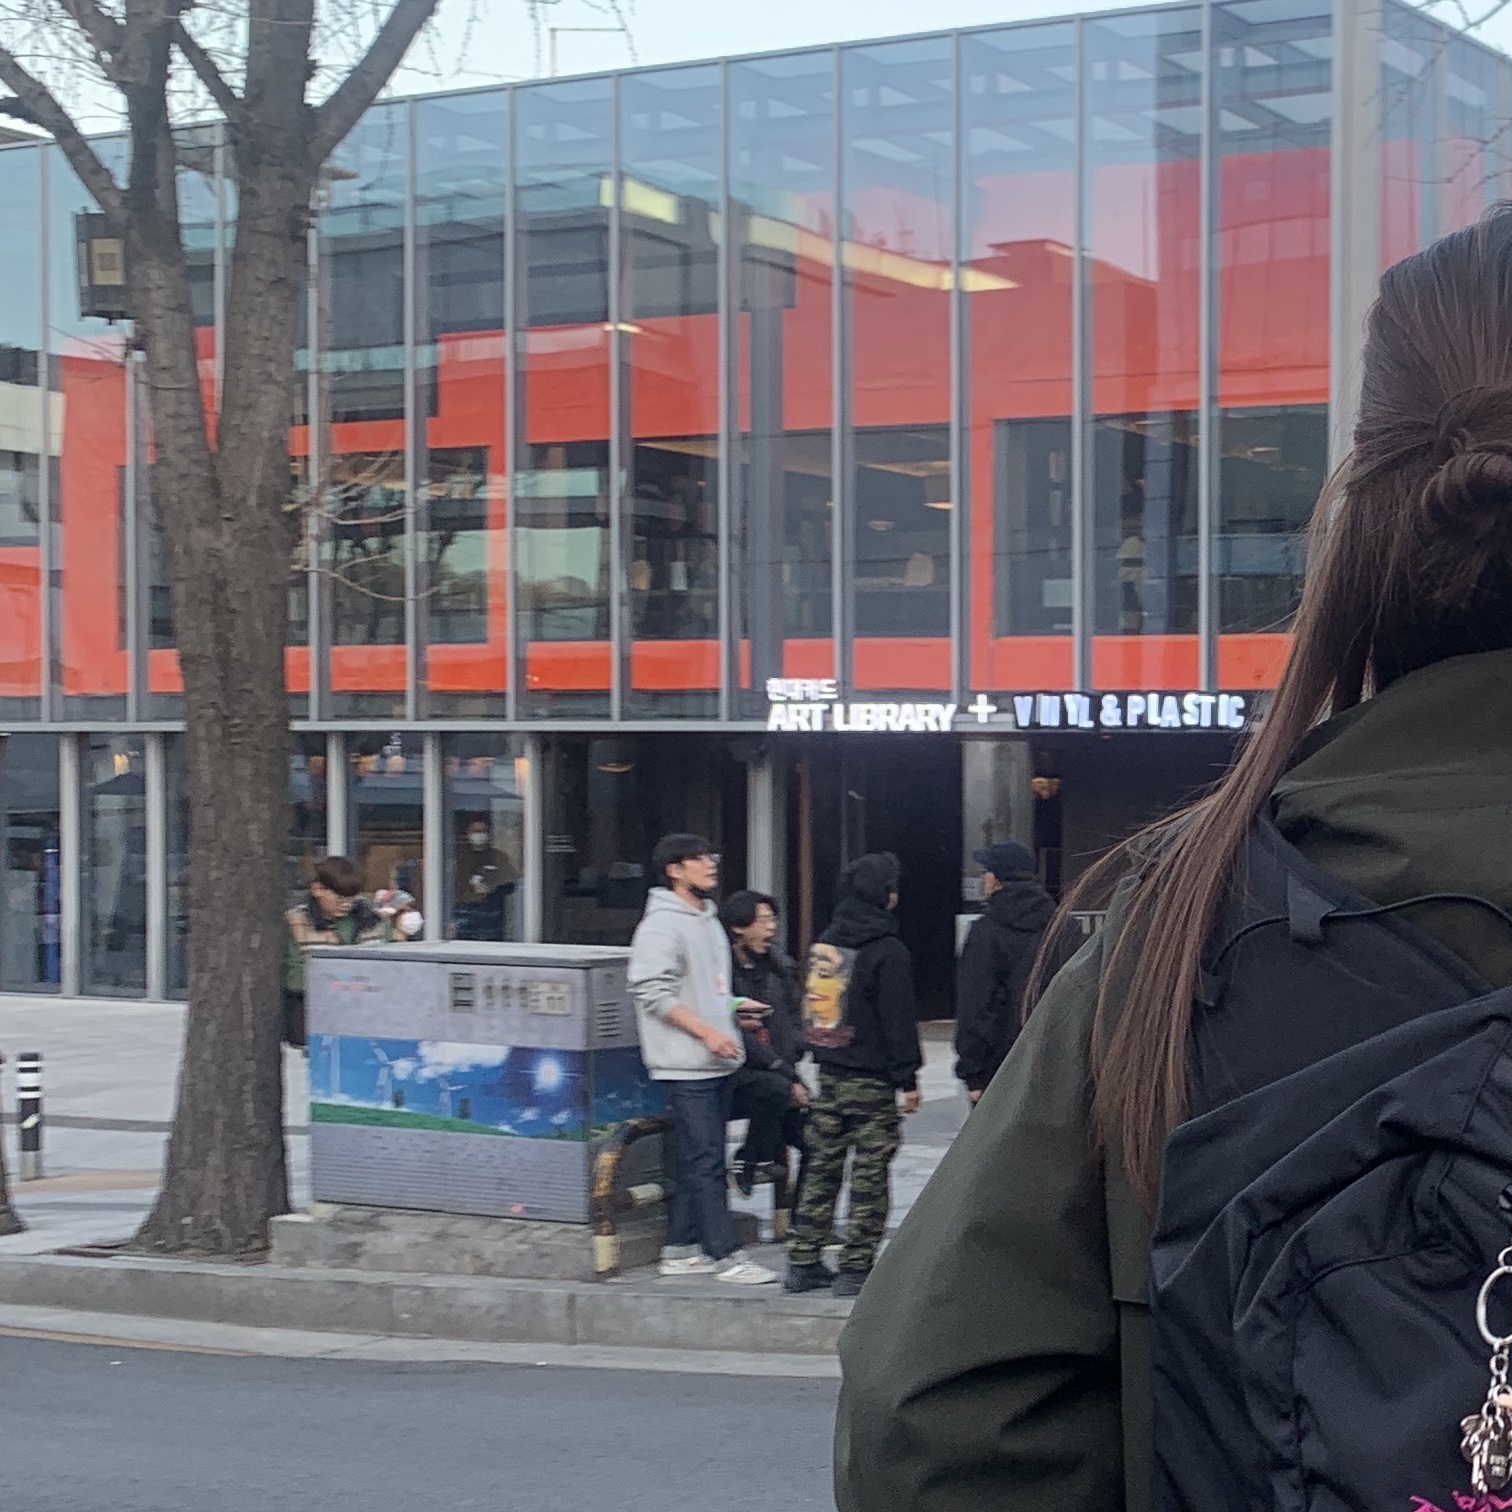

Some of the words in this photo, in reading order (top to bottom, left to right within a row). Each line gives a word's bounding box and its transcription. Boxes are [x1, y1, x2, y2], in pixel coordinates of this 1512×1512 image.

[767, 703, 829, 732] ART
[832, 703, 957, 732] LIBRARY
[1013, 692, 1095, 728] VINYL
[1100, 693, 1123, 727] &
[1126, 692, 1246, 729] PLASTIC
